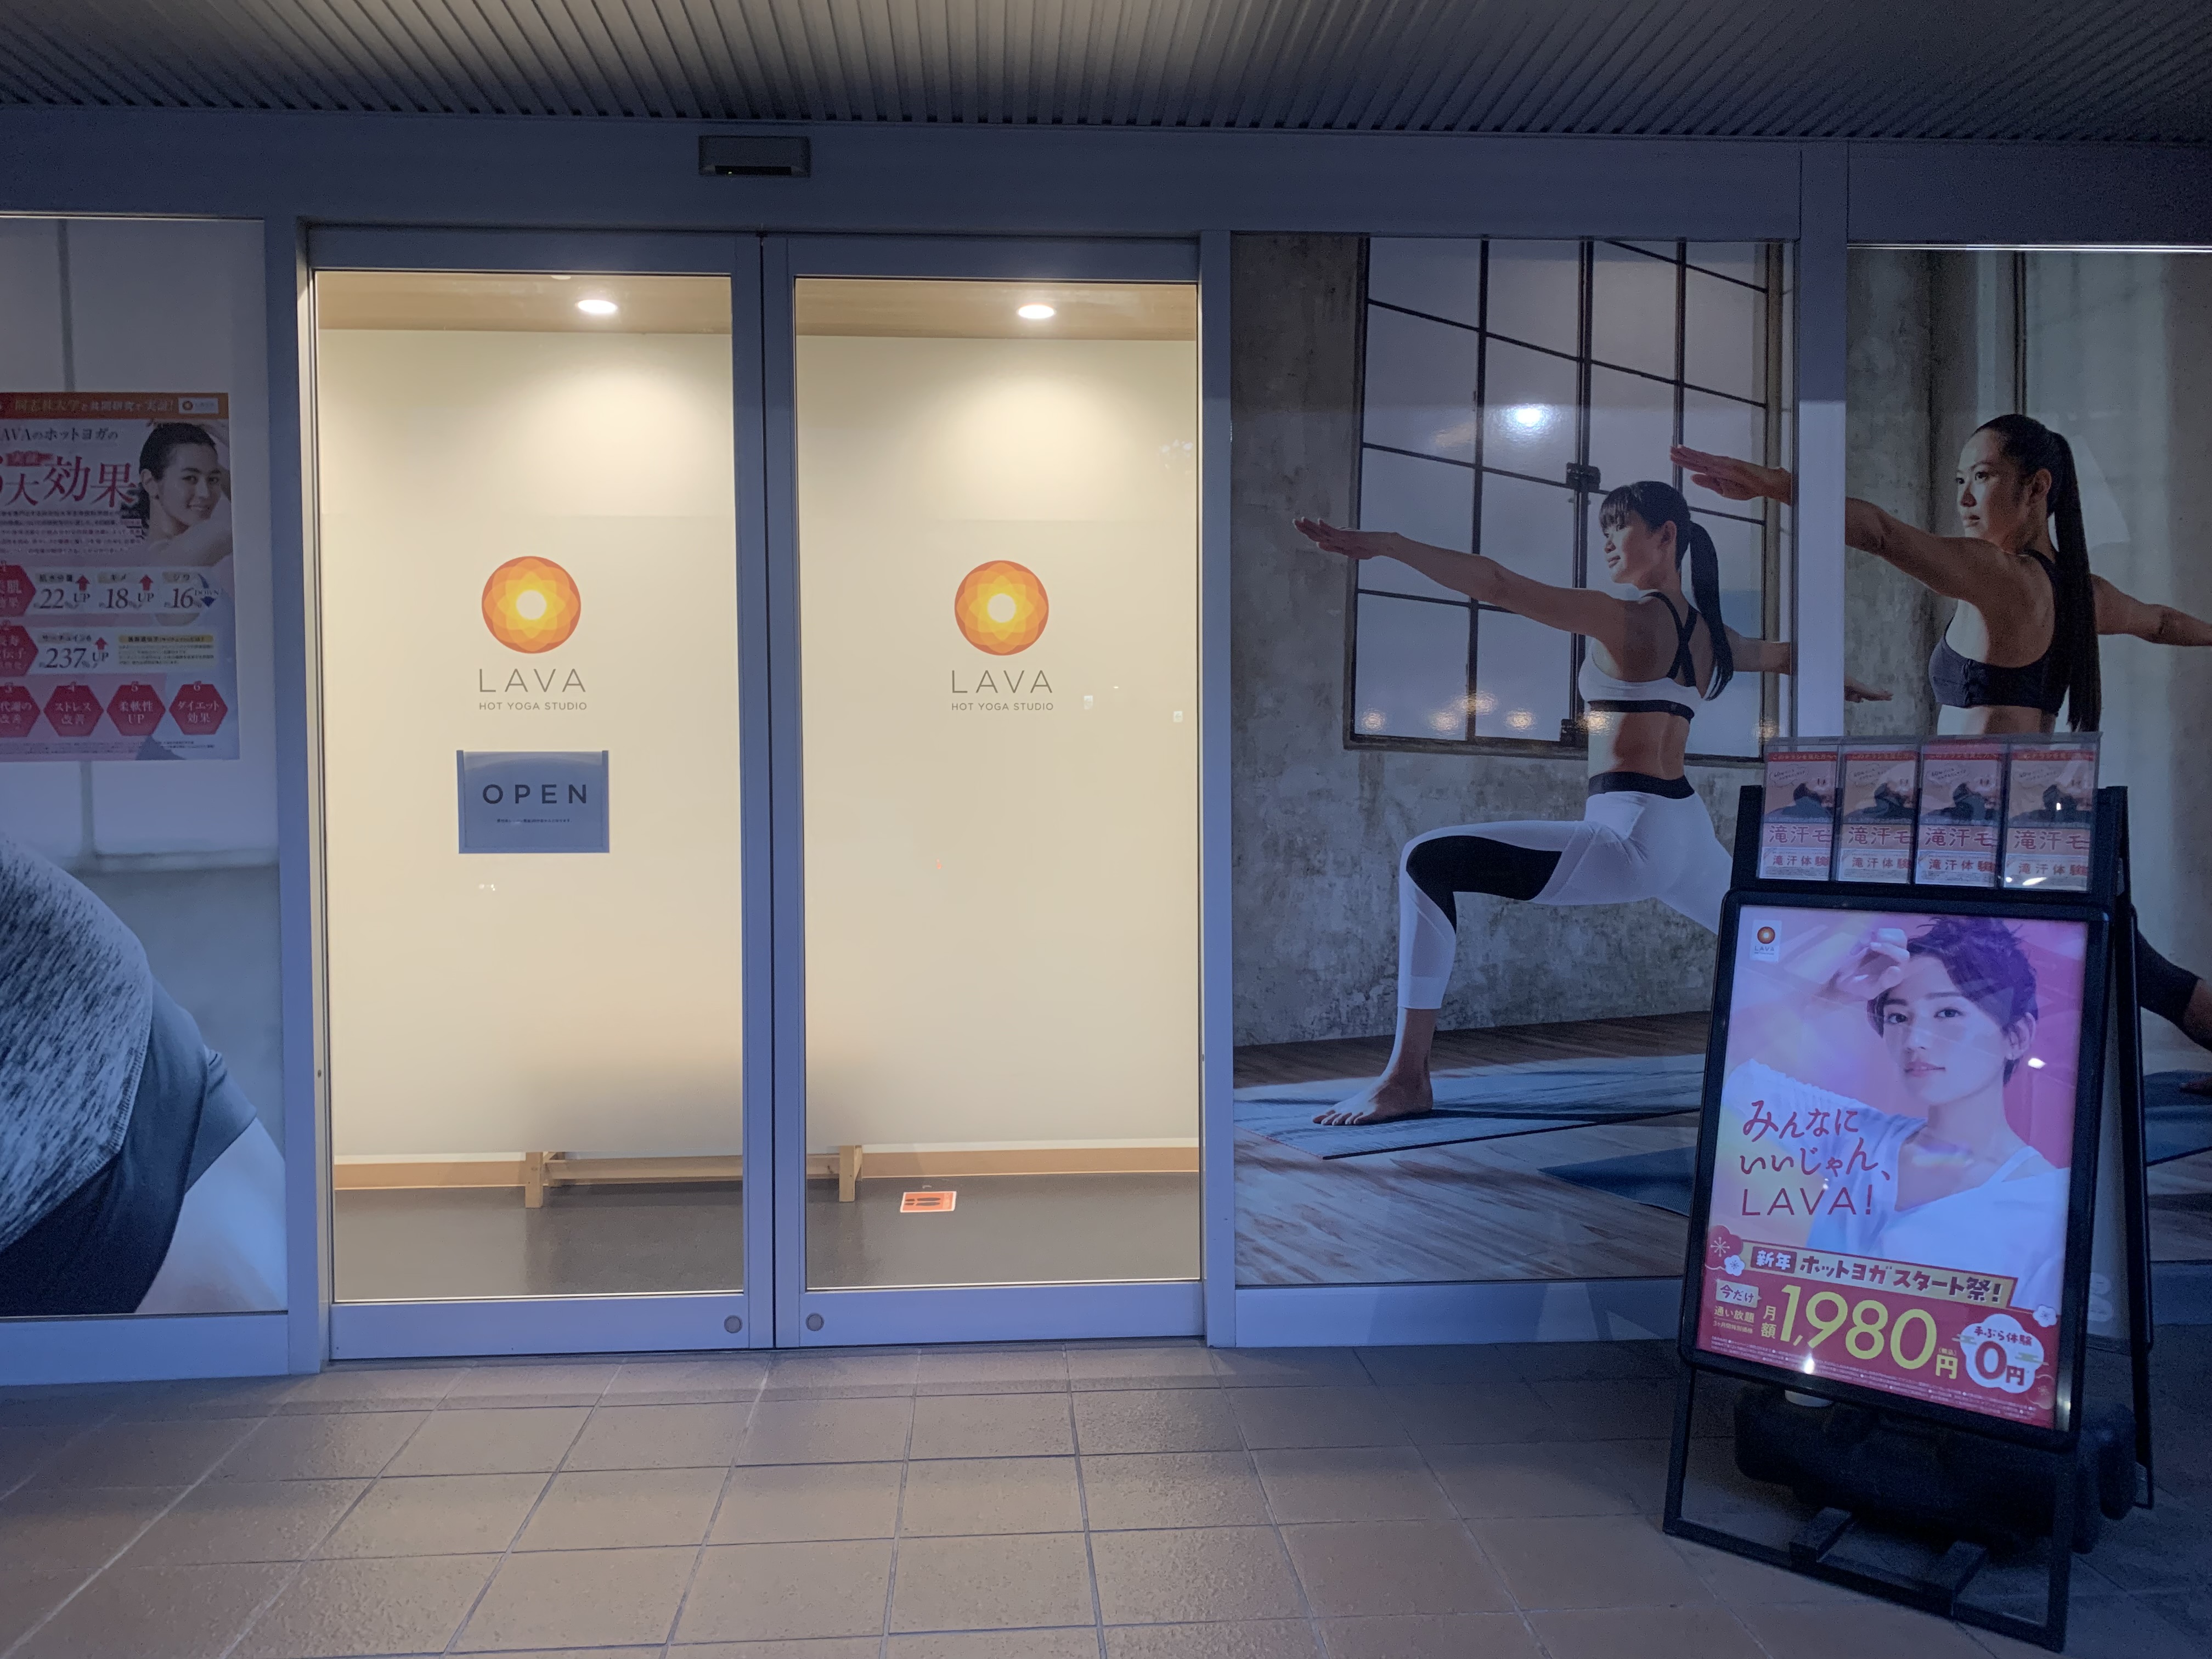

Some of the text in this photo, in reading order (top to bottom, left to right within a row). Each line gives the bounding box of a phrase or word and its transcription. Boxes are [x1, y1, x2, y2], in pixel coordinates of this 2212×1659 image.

[74, 592, 91, 603] UP
[137, 592, 154, 602] UP
[92, 652, 109, 662] UP
[479, 668, 586, 693] LAVA
[952, 669, 1053, 693] LAVA
[55, 702, 92, 712] ストレス
[177, 701, 220, 712] ダイエット
[479, 702, 587, 710] HOT YOGA STUDIO
[951, 702, 1054, 711] HOT YOGA STUDIO
[128, 714, 145, 725] UP
[482, 783, 587, 804] OPEN
[1742, 1100, 1859, 1142] みんなに
[1739, 1137, 1891, 1181] いいじゃん、
[1741, 1184, 1873, 1216] LAVA!
[1756, 1249, 1792, 1271] 新年
[1720, 1284, 1754, 1304] 今だけ
[1713, 1305, 1755, 1324] 通い放題
[1760, 1305, 1777, 1339] 月額
[1974, 1325, 2033, 1347] 手ぶら体験
